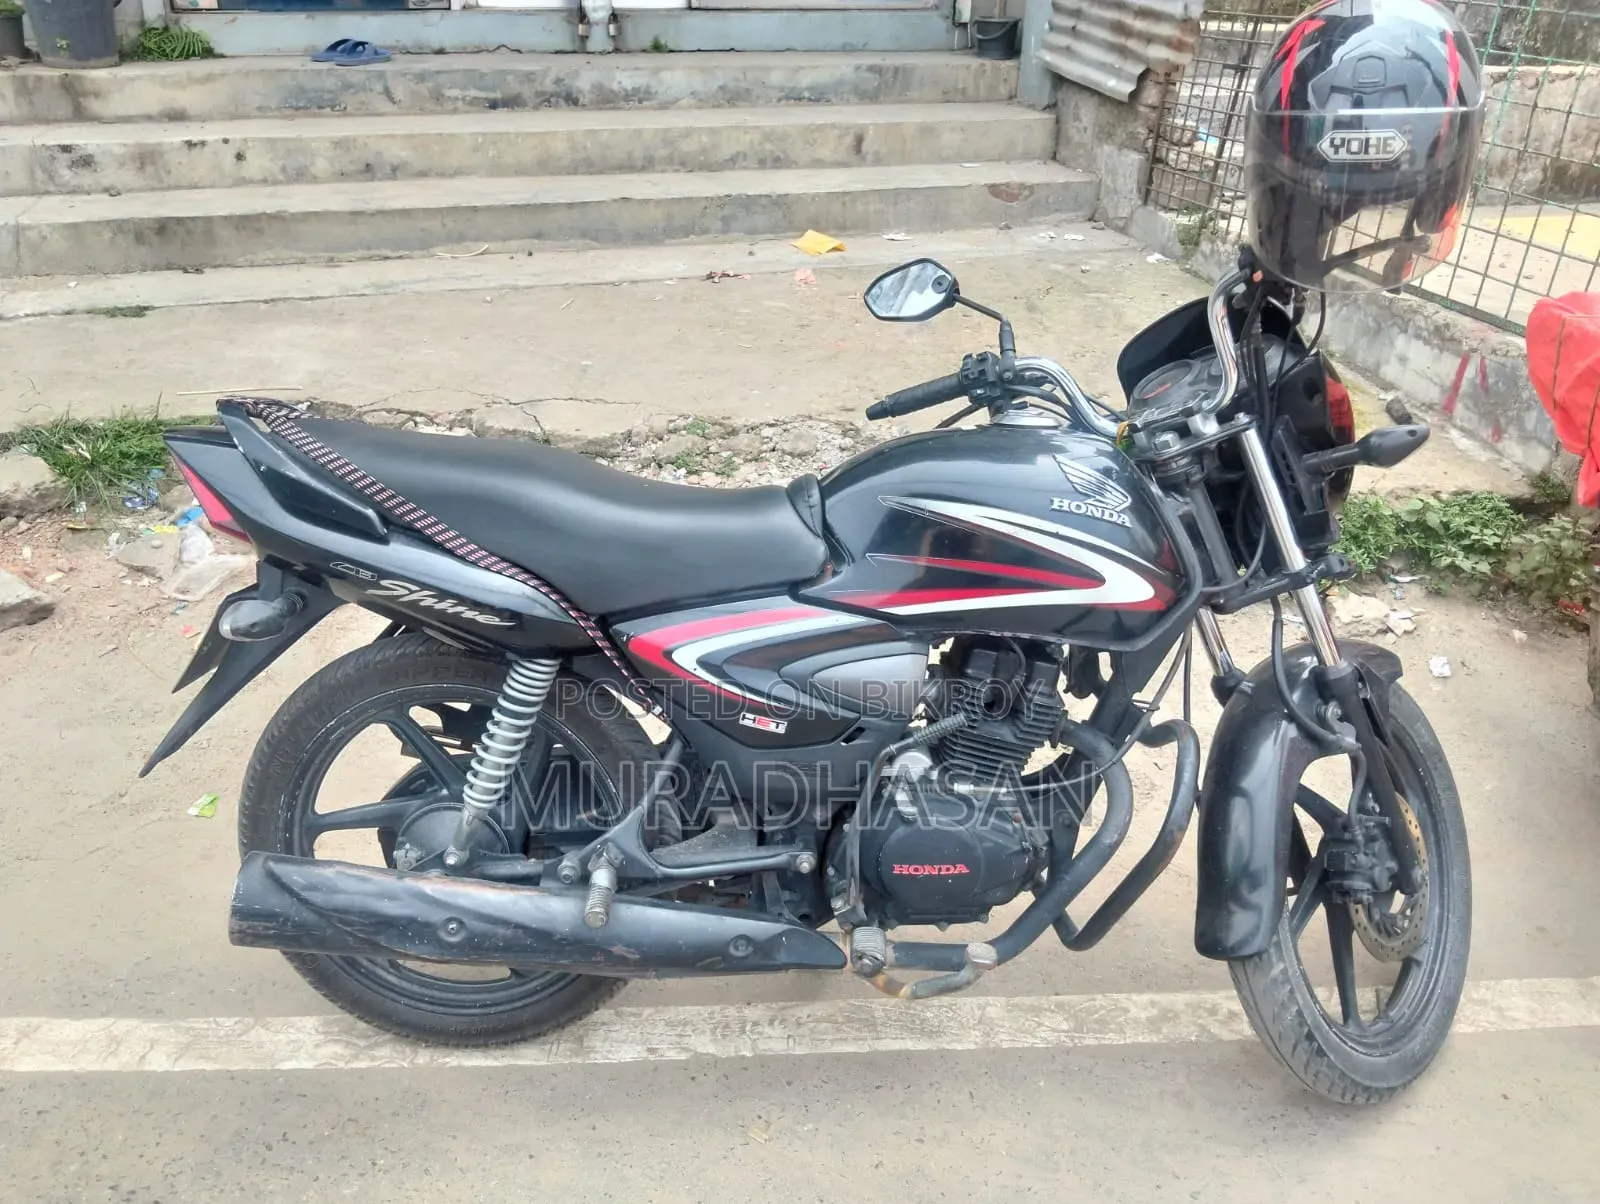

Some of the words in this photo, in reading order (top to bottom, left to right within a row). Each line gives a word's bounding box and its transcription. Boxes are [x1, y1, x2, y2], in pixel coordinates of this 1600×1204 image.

[1328, 136, 1396, 155] YOHE
[1049, 498, 1132, 528] HONDA
[366, 579, 516, 626] Shine
[740, 713, 786, 732] HET
[892, 863, 970, 875] HONDA
